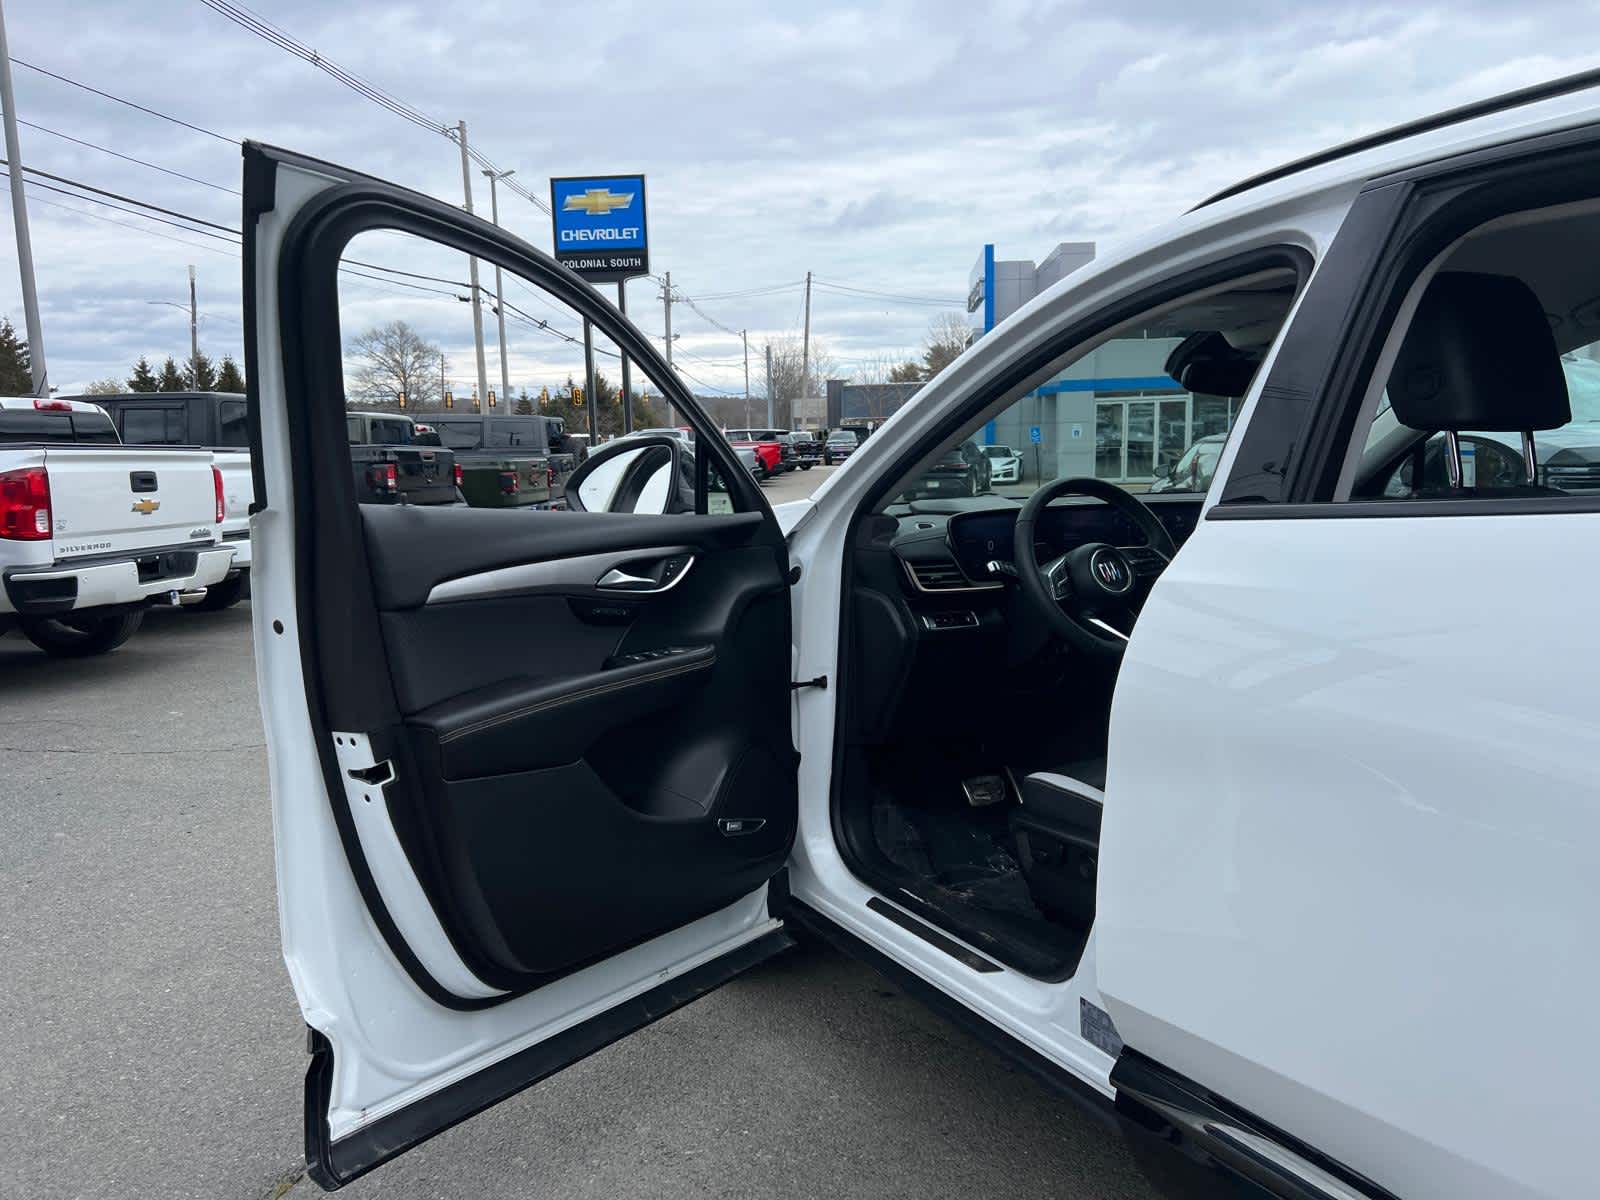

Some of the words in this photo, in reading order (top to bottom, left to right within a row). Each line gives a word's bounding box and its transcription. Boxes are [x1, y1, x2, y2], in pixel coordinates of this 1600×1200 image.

[561, 228, 639, 241] CHEVROLET
[562, 259, 607, 268] COLONIAL
[610, 258, 641, 267] SOUTH
